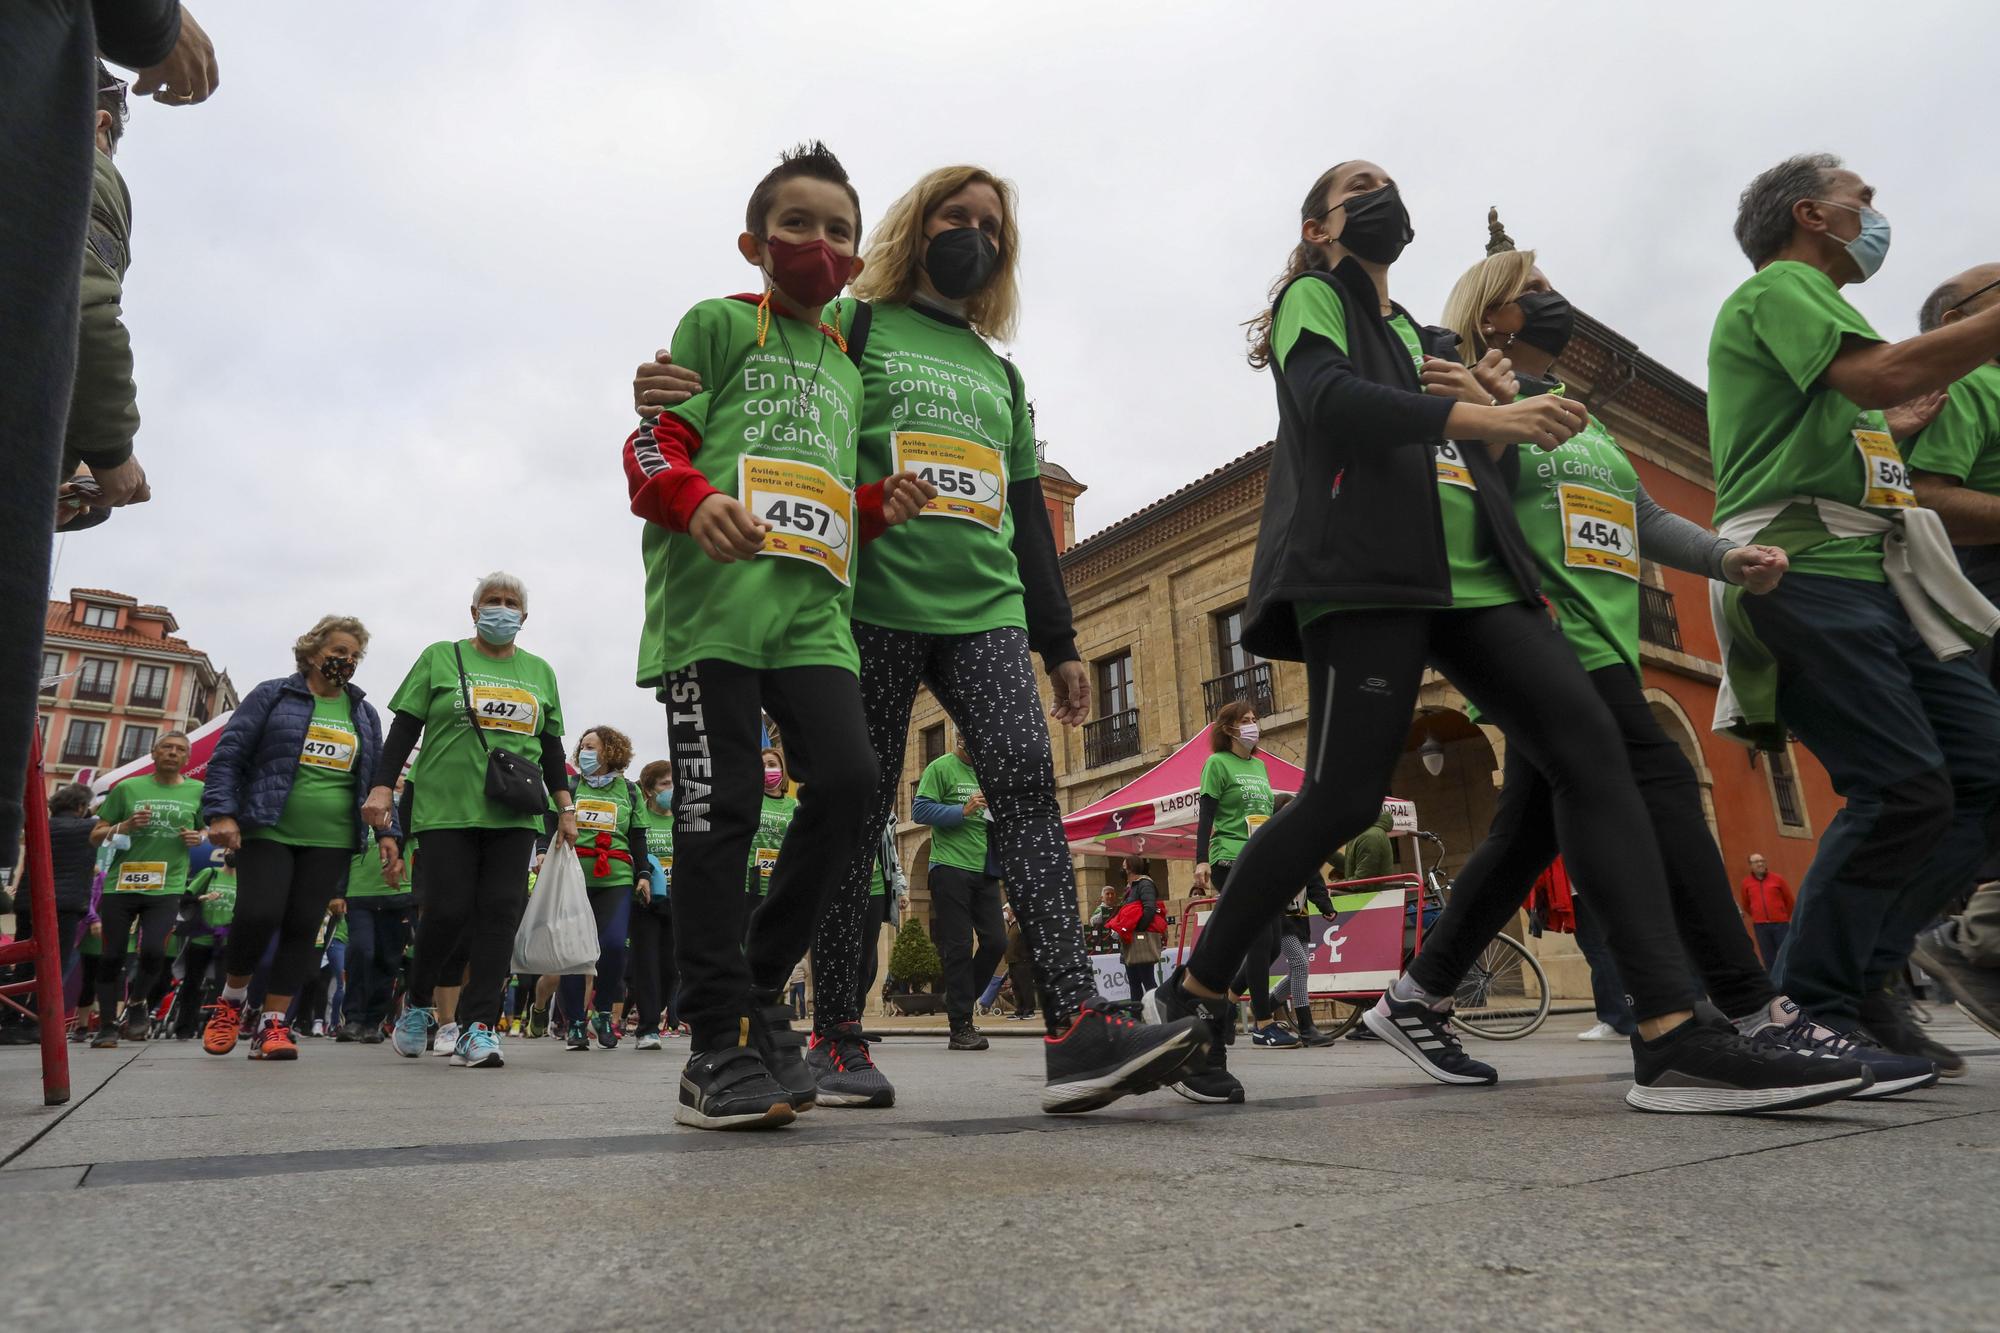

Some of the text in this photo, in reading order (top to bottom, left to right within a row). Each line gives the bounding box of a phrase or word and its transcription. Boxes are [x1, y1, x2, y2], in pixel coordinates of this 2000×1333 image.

[884, 359, 913, 375] En
[919, 364, 991, 393] marcha
[744, 368, 776, 391] En
[784, 374, 849, 421] marcha
[888, 379, 958, 401] contra
[892, 397, 982, 430] el cáncer
[744, 420, 839, 460] el cáncer
[902, 448, 929, 456] contra
[940, 451, 965, 460] cáncer
[751, 466, 779, 476] Avilés
[918, 467, 976, 496] 455
[1537, 456, 1613, 482] el cáncer
[751, 476, 782, 486] contra
[795, 481, 825, 495] cáncer
[766, 500, 831, 537] 457
[1578, 521, 1622, 551] 454
[483, 701, 518, 717] 447
[305, 742, 336, 756] 470
[677, 735, 712, 832] TEAM
[586, 811, 599, 821] 77
[125, 873, 150, 883] 458
